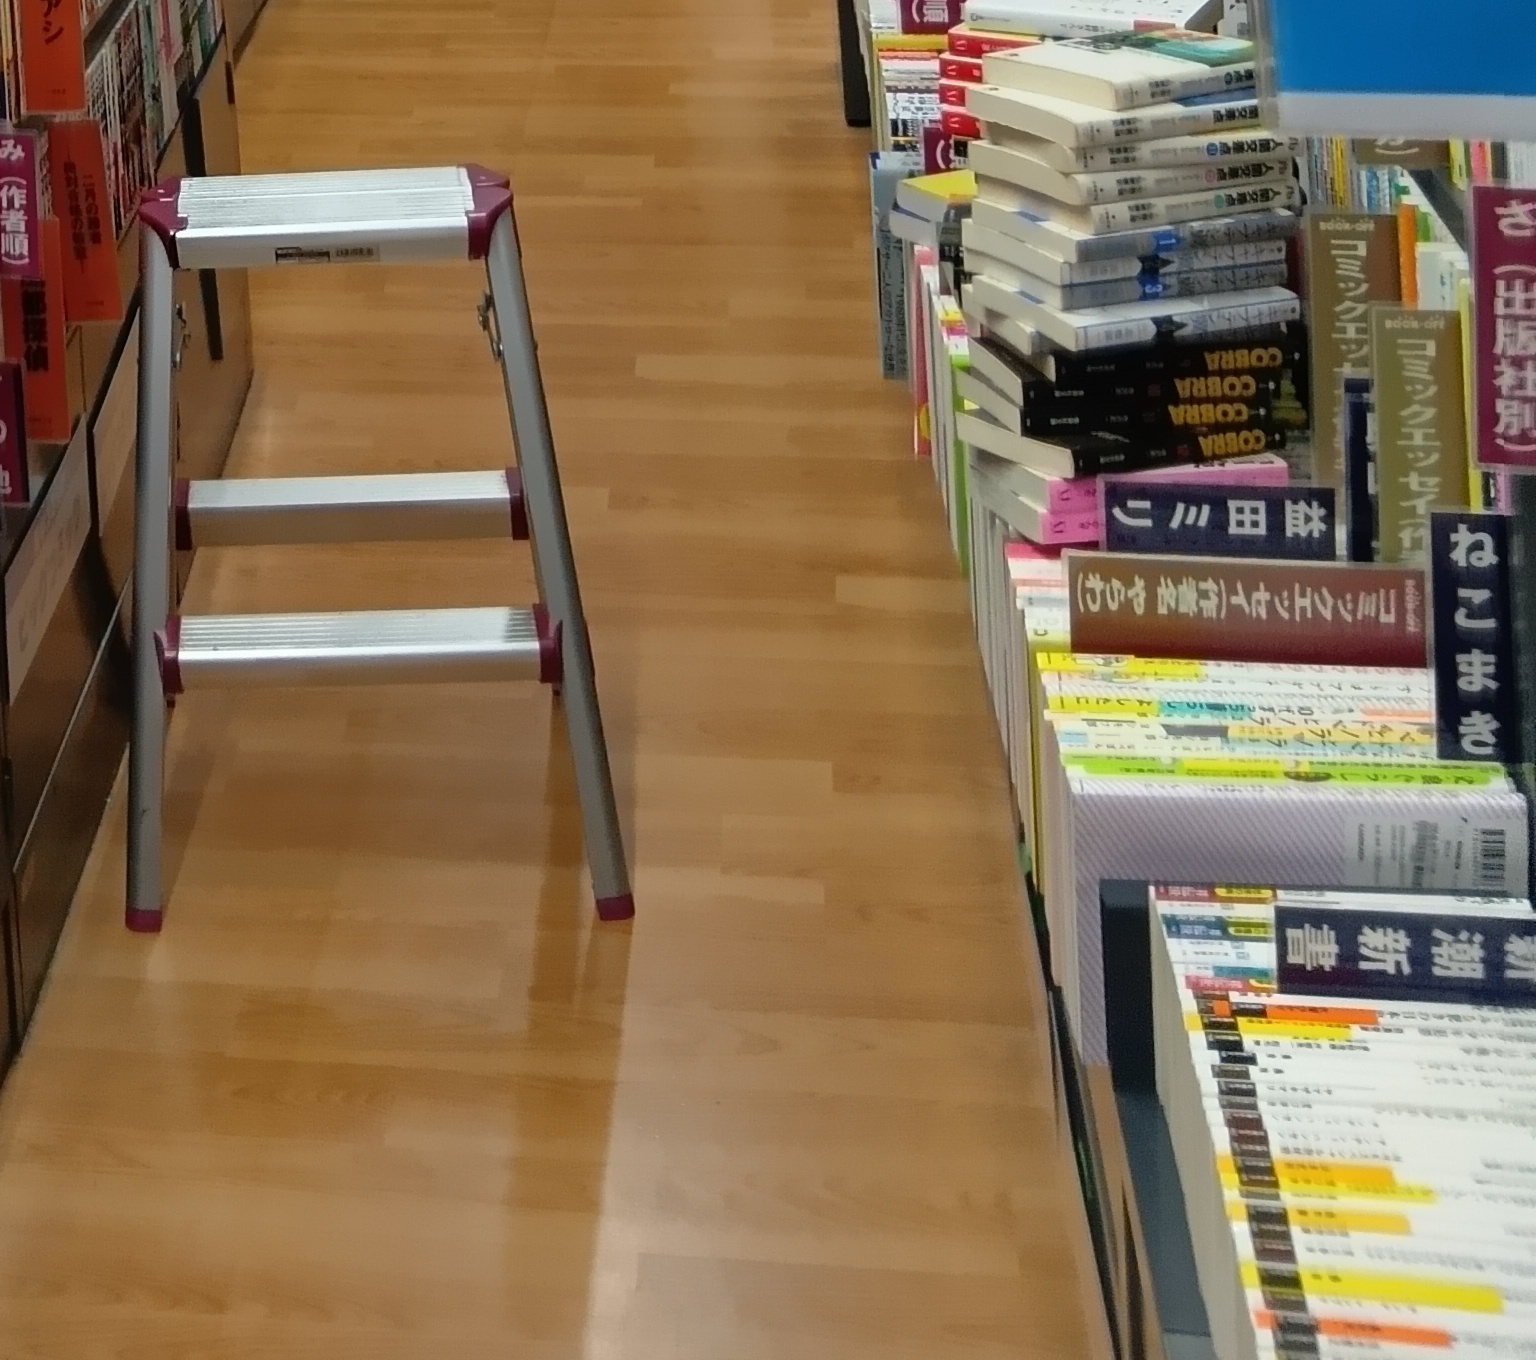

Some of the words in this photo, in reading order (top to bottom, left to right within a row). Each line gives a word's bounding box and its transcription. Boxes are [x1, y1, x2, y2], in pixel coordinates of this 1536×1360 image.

[1204, 346, 1282, 372] COBRA
[1175, 375, 1256, 400] COBRA
[1169, 402, 1249, 427] COBRA
[1197, 429, 1266, 459] COBRA
[1448, 521, 1501, 757] ねこまき
